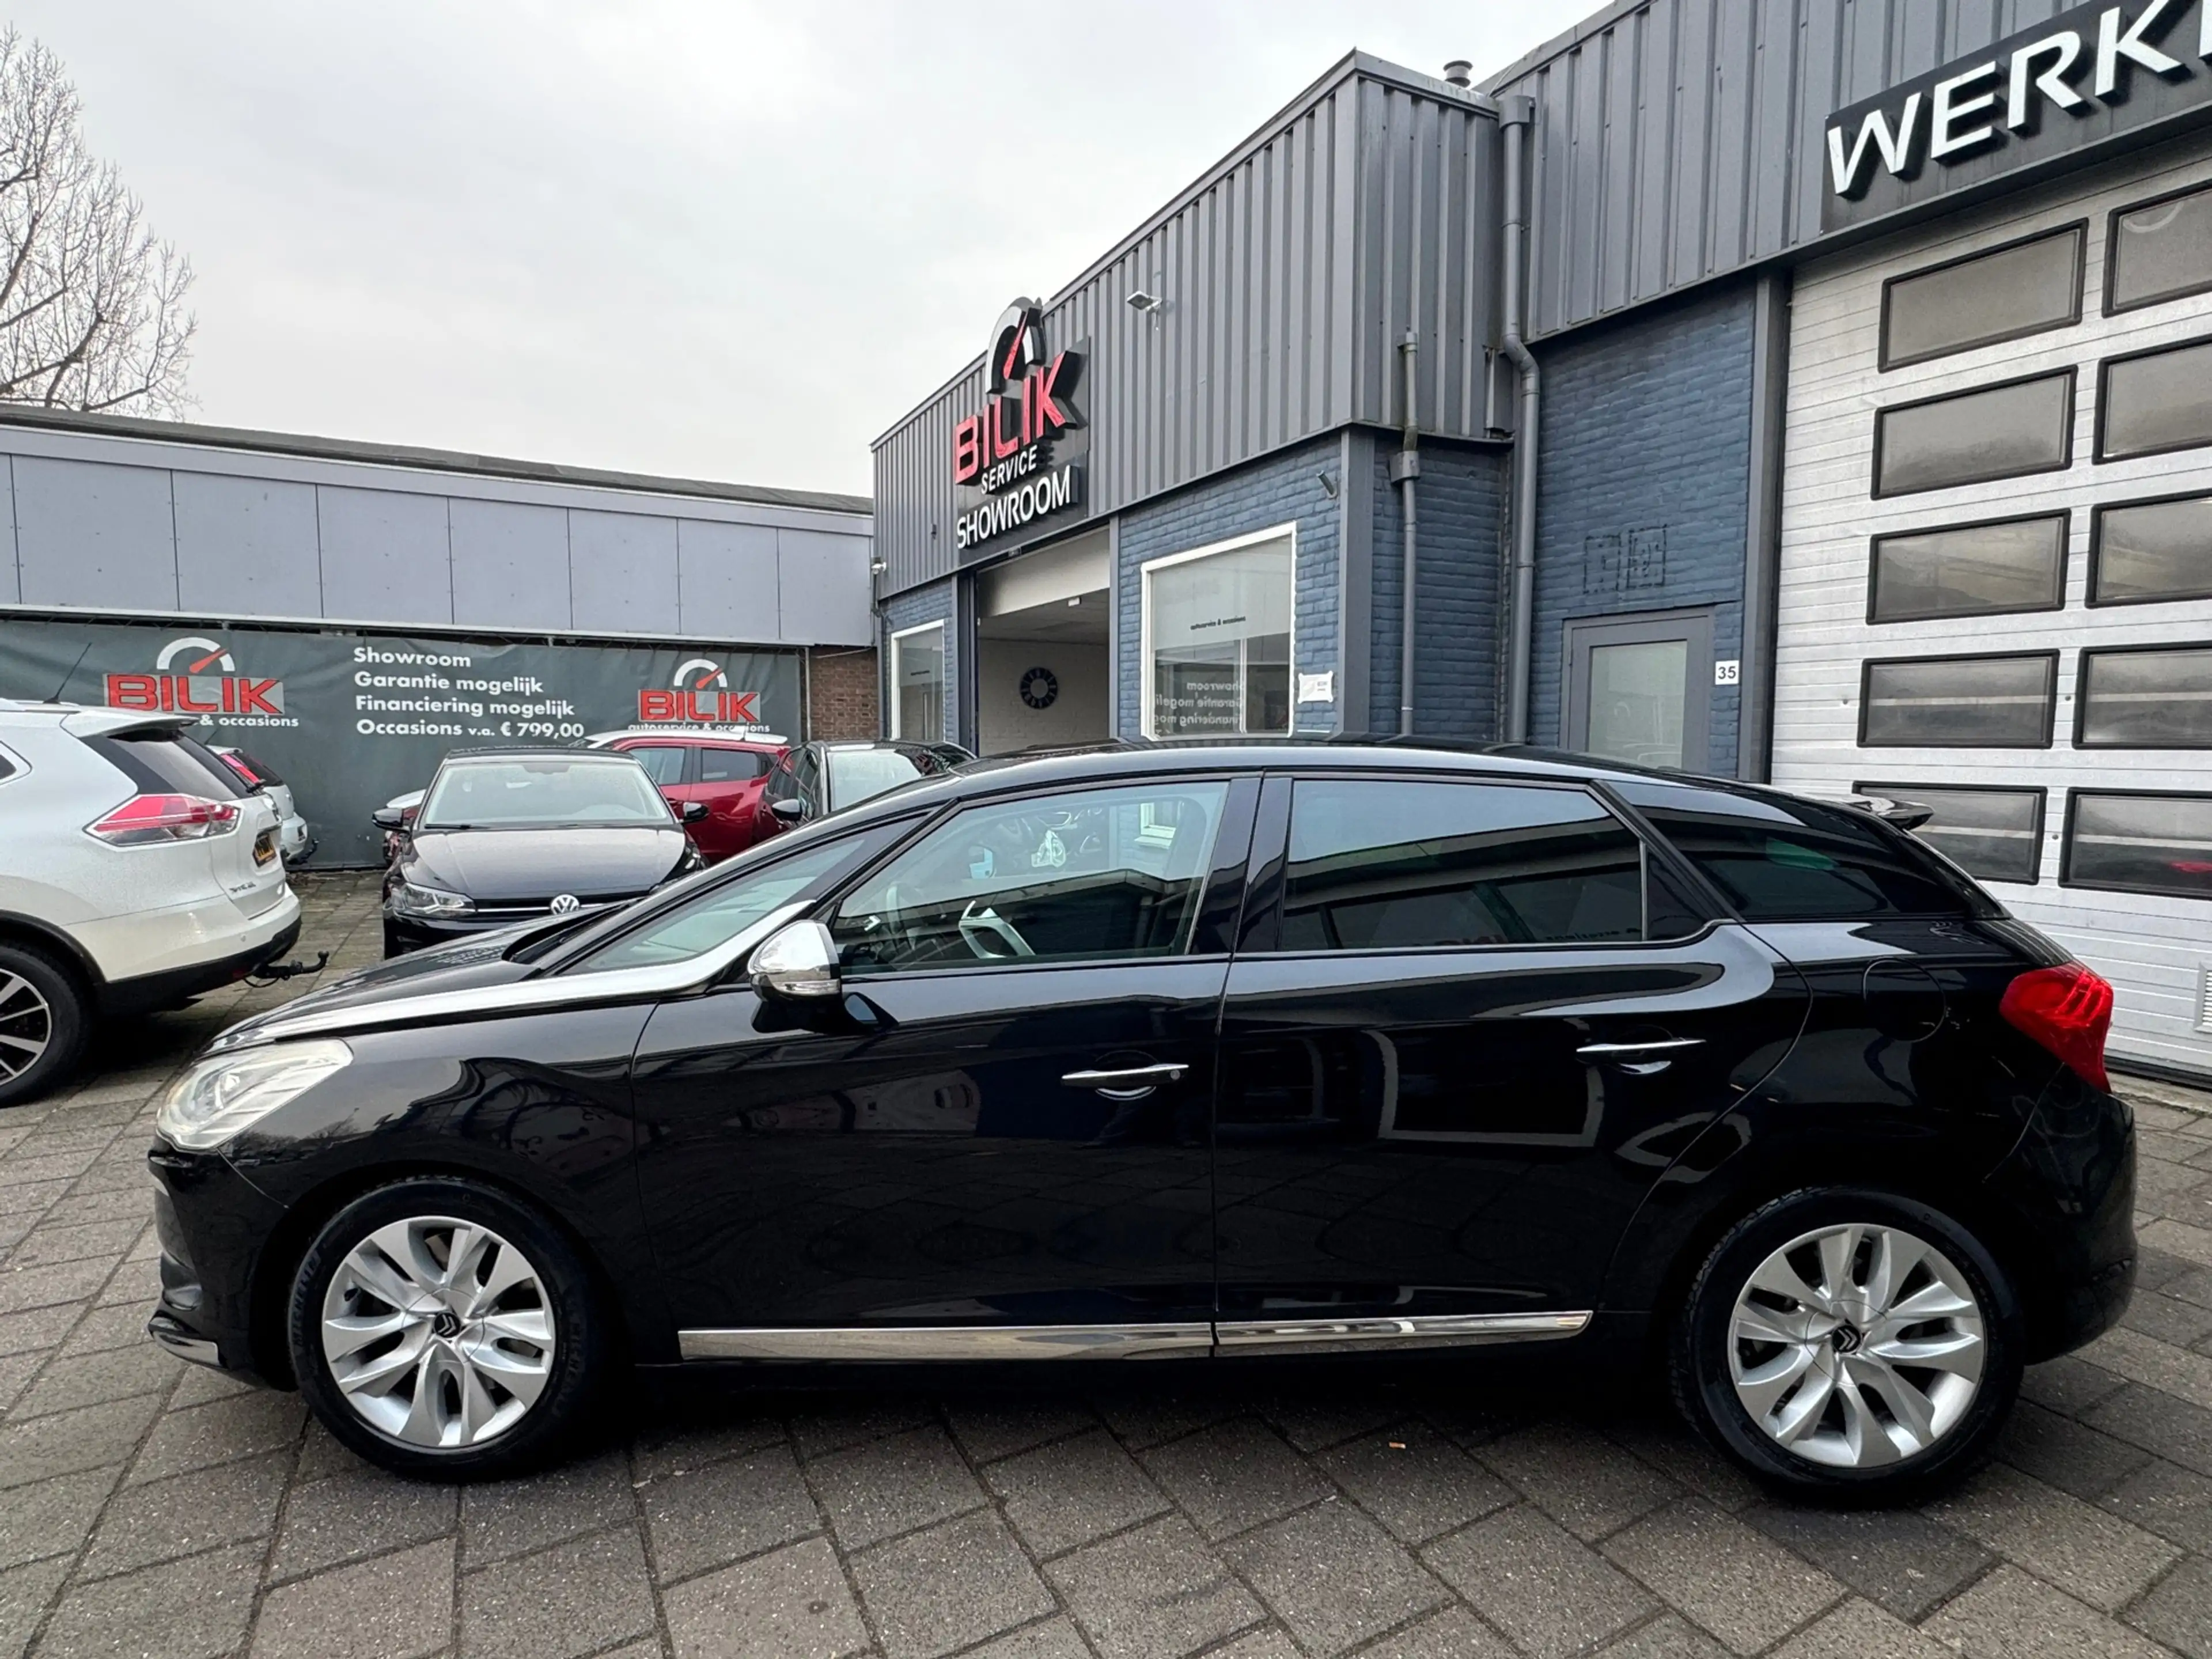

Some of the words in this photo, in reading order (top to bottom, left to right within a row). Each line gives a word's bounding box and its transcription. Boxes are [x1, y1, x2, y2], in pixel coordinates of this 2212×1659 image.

[1827, 0, 2212, 196] WERK
[955, 350, 1066, 484] BILIK
[981, 445, 1037, 495] SERVICE
[957, 464, 1071, 549] SHOWROOM
[354, 646, 471, 667] Showroom
[354, 671, 450, 688] Garantie
[456, 676, 544, 696] mogelijk
[1718, 666, 1736, 680] 35
[107, 674, 283, 714] BILIK
[355, 695, 483, 717] Financiering
[490, 699, 575, 719] mogelijk
[641, 690, 759, 722] BILIK
[200, 714, 214, 726] &
[219, 715, 300, 727] occasions
[357, 719, 463, 735] Occasions
[468, 728, 495, 736] v.a.
[500, 721, 512, 737] €
[517, 722, 584, 740] 799,00
